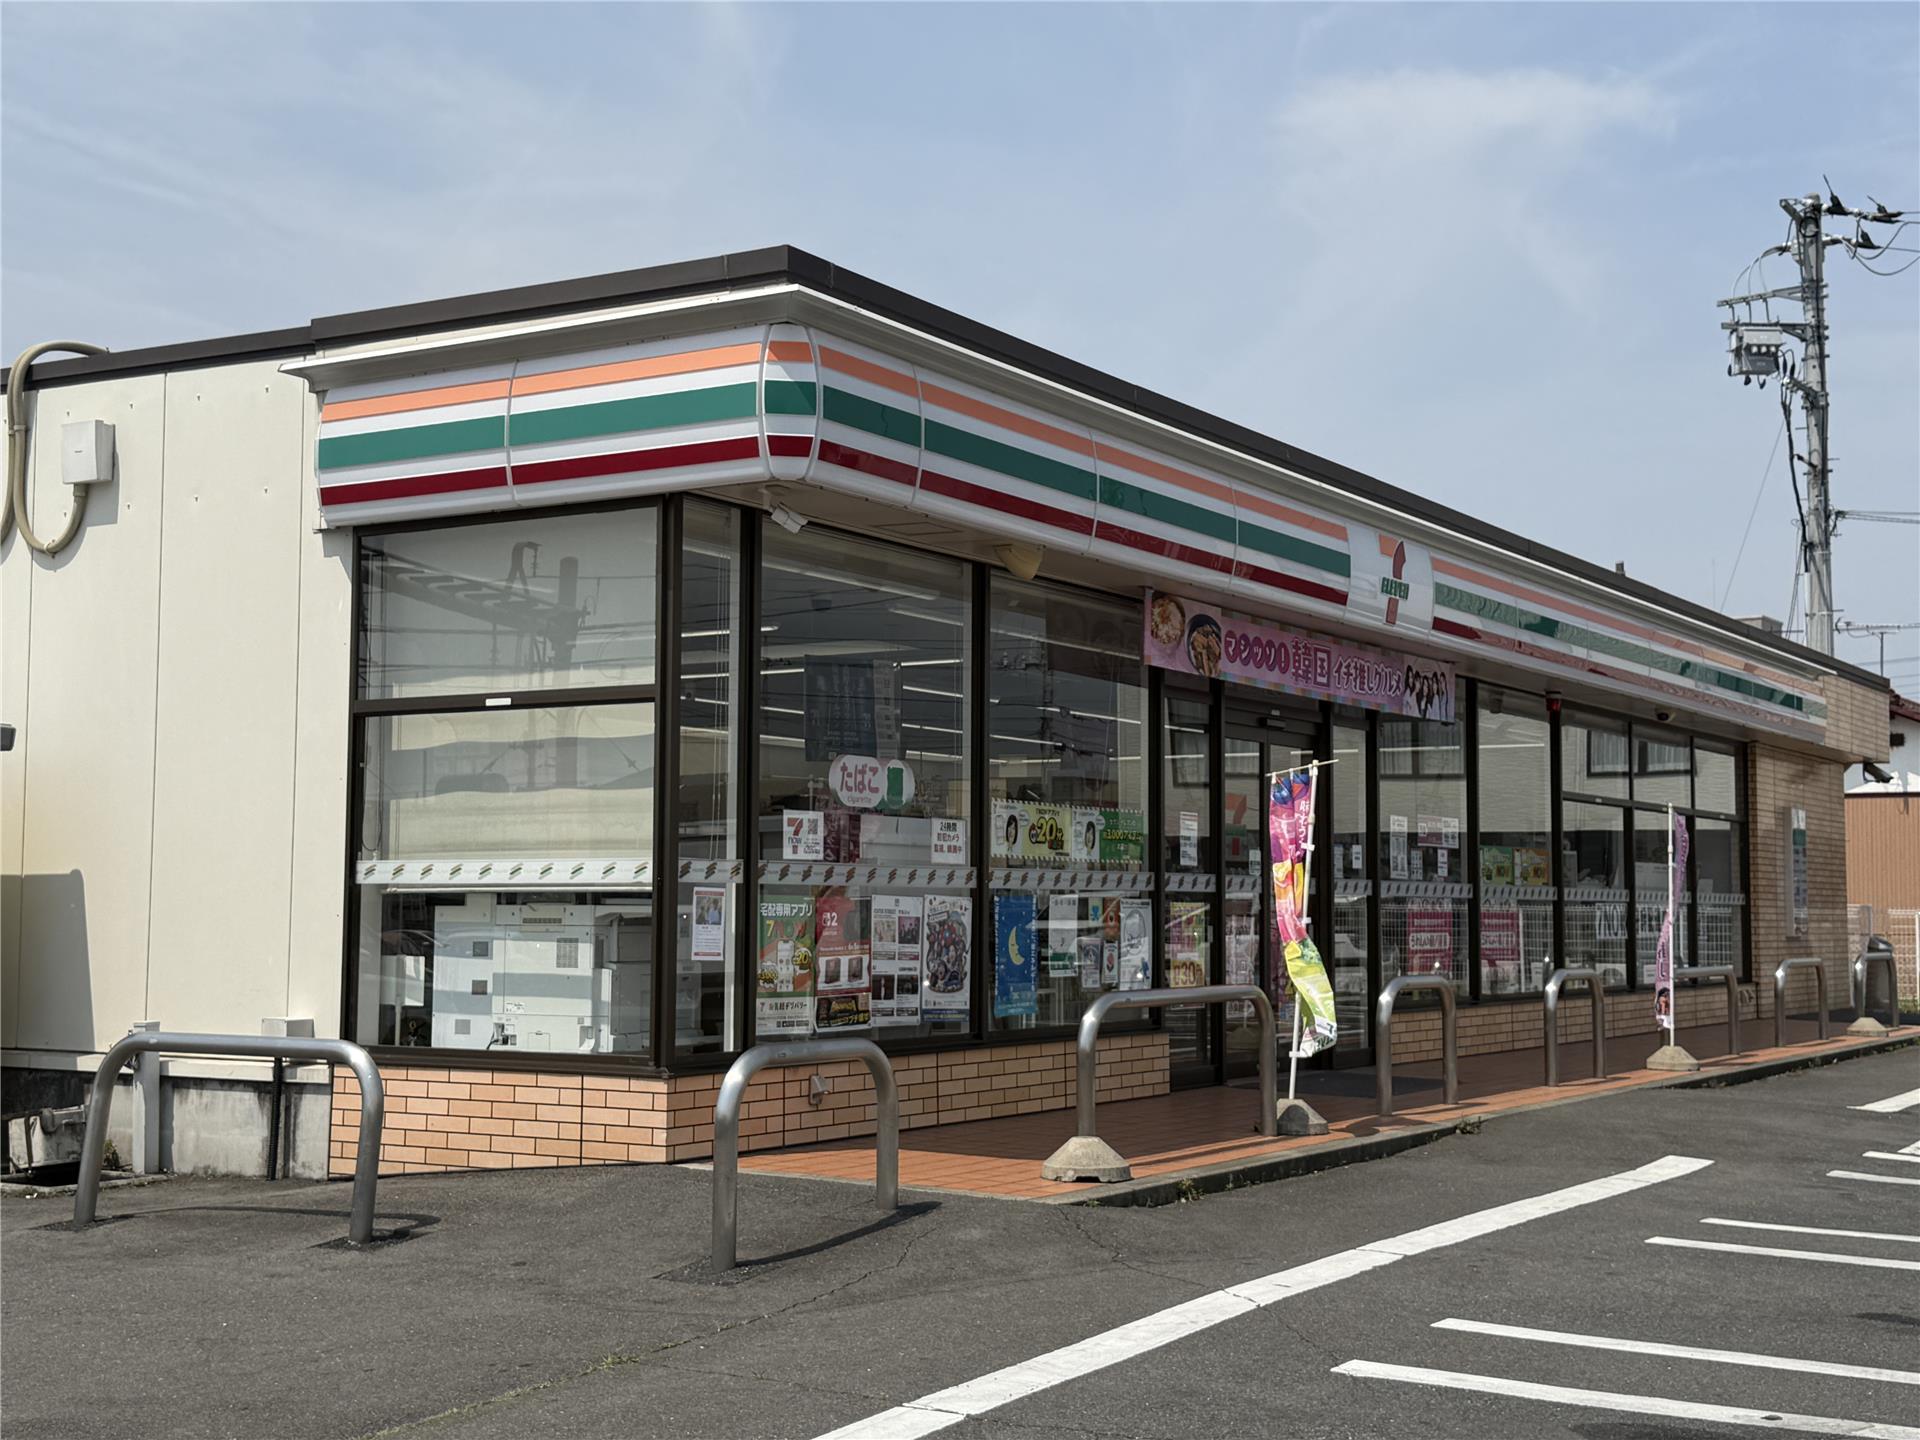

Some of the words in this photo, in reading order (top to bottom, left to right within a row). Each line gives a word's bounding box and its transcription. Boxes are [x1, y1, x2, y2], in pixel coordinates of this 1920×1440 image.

[1381, 576, 1410, 600] ELEVEN
[840, 761, 880, 794] たばこ
[760, 902, 813, 917] 宅配専用アプリ
